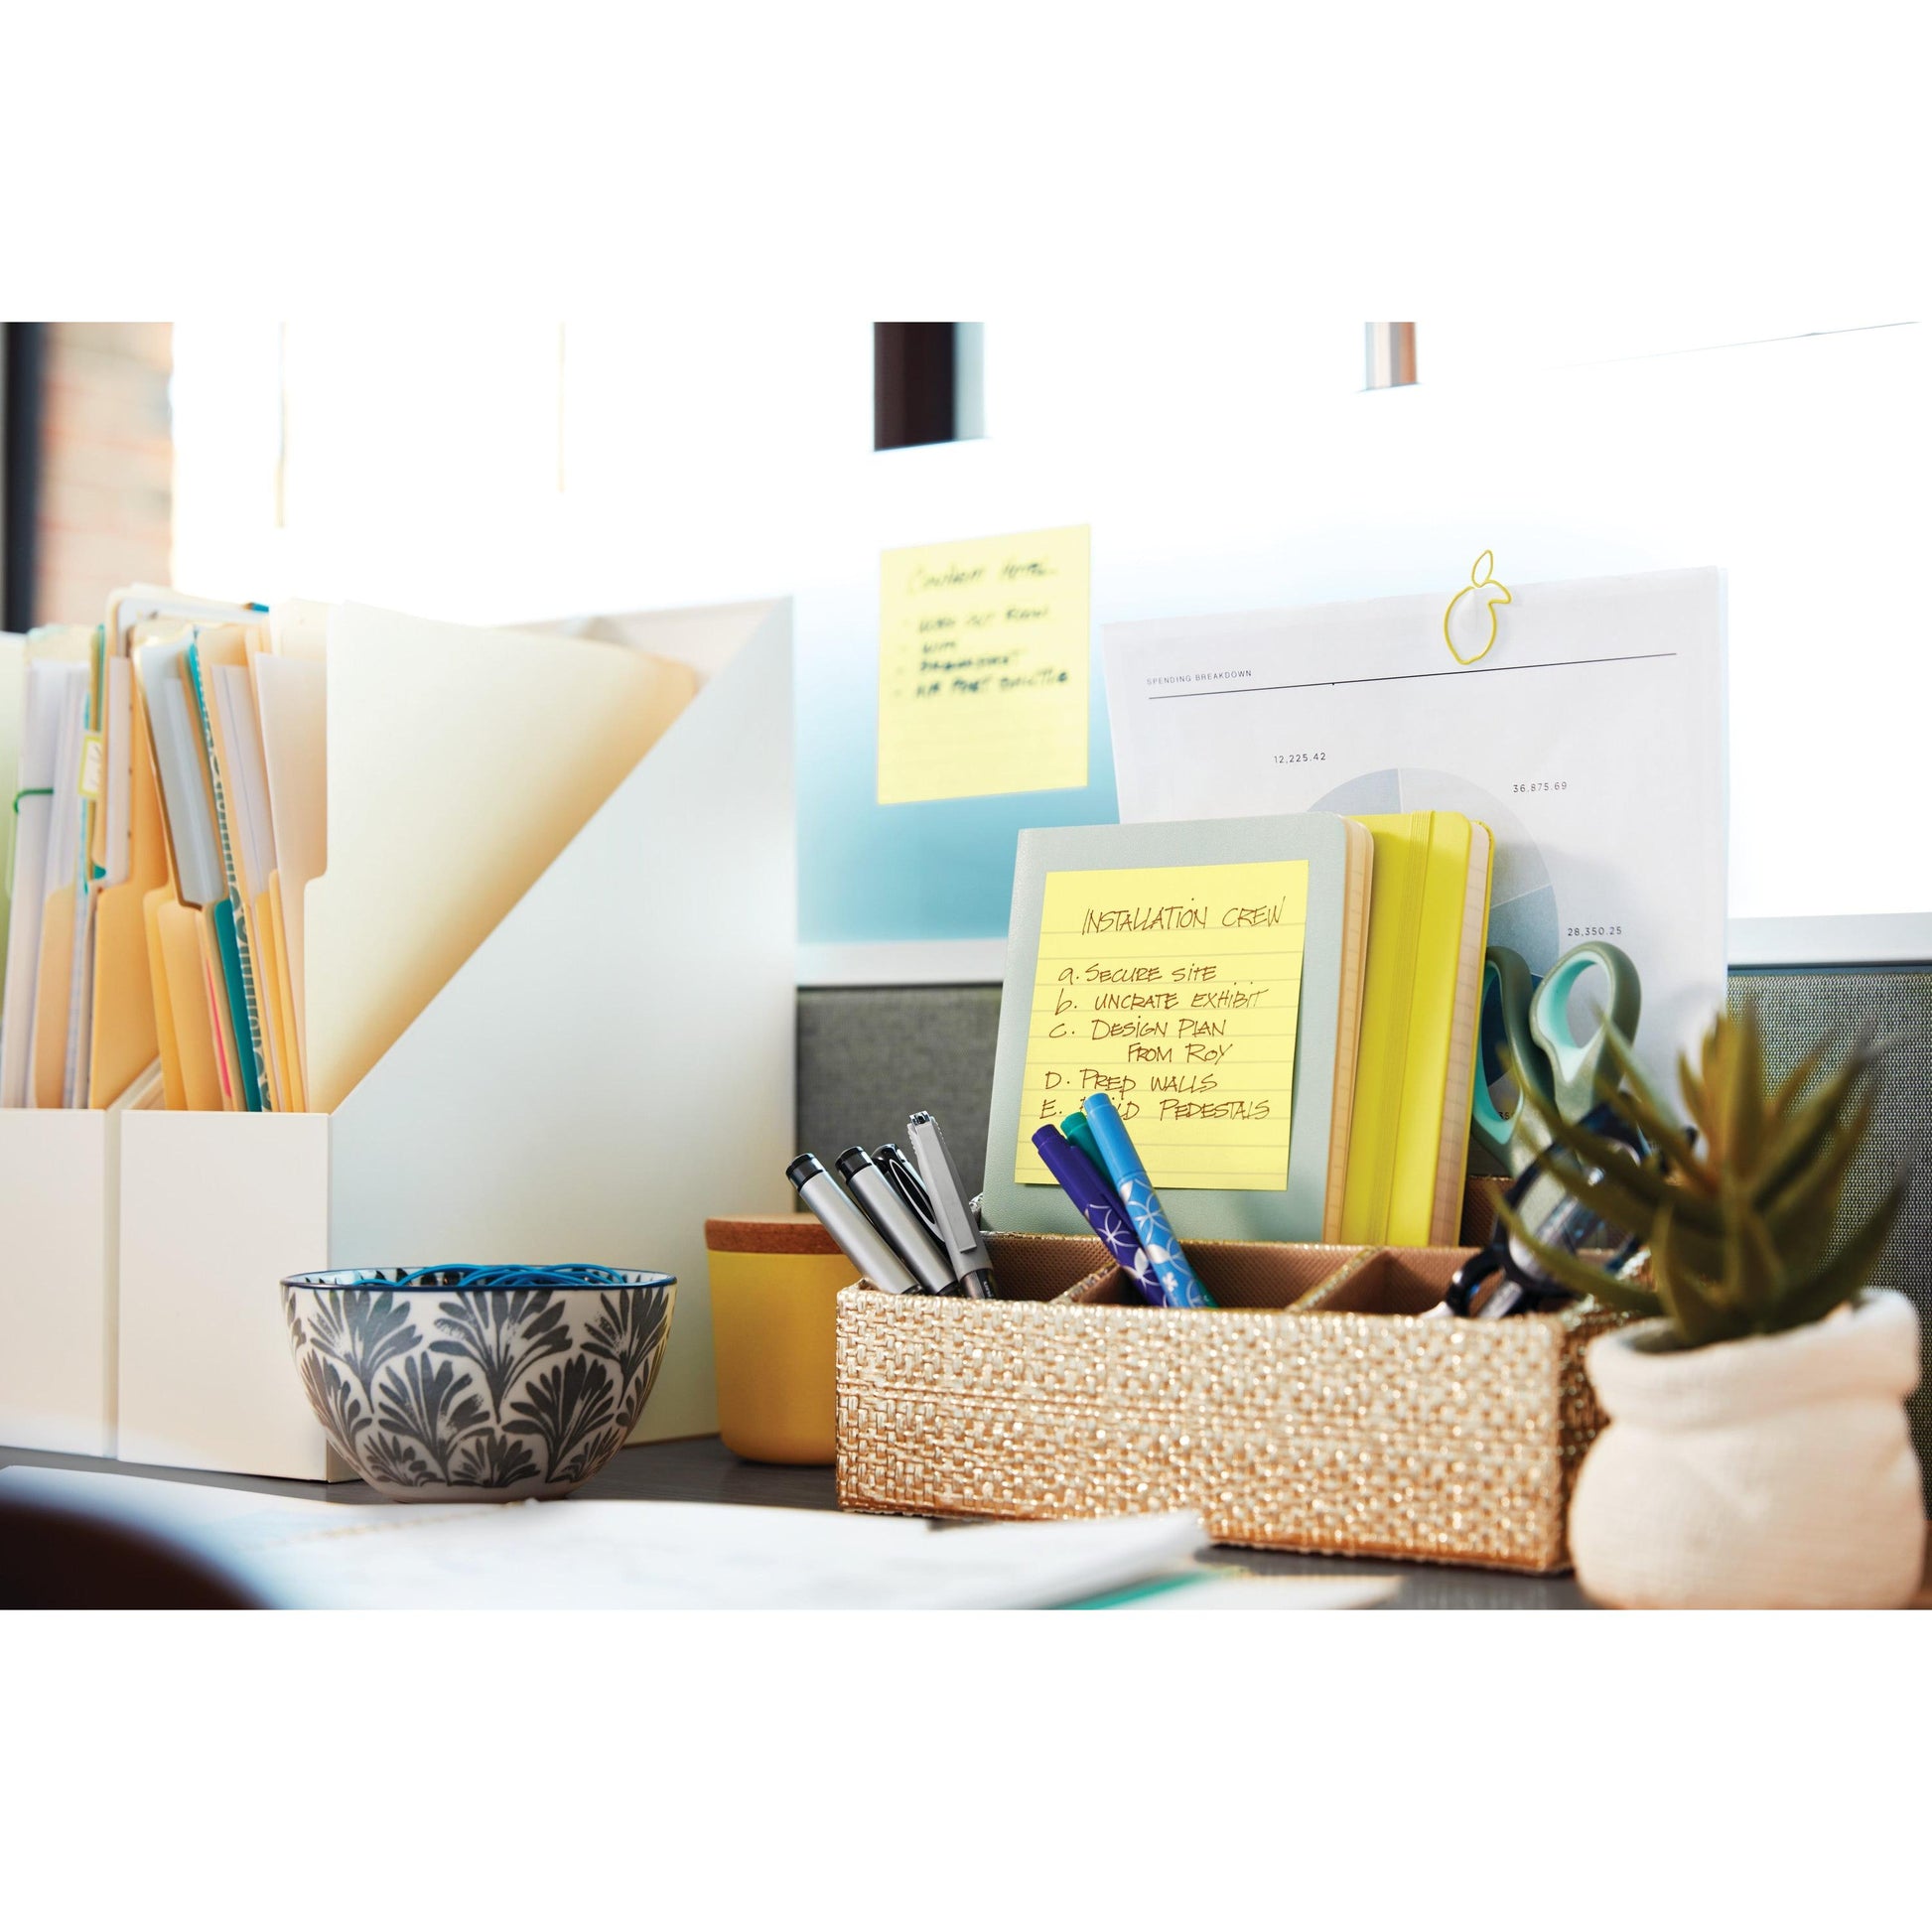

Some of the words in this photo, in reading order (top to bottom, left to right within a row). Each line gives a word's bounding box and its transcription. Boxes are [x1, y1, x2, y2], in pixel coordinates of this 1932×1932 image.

[1146, 675, 1192, 685] SPENDING
[1194, 670, 1252, 682] BREAKDOWN
[1221, 896, 1287, 927] CREW
[1085, 963, 1164, 983] SECURE
[1094, 993, 1179, 1011] UNCRATE
[1177, 1019, 1227, 1038] PLAN
[1127, 1042, 1173, 1063] FROM
[1079, 1068, 1138, 1101] PREP
[1151, 1073, 1218, 1093] WALLS
[1159, 1098, 1271, 1121] PEDESTALS
